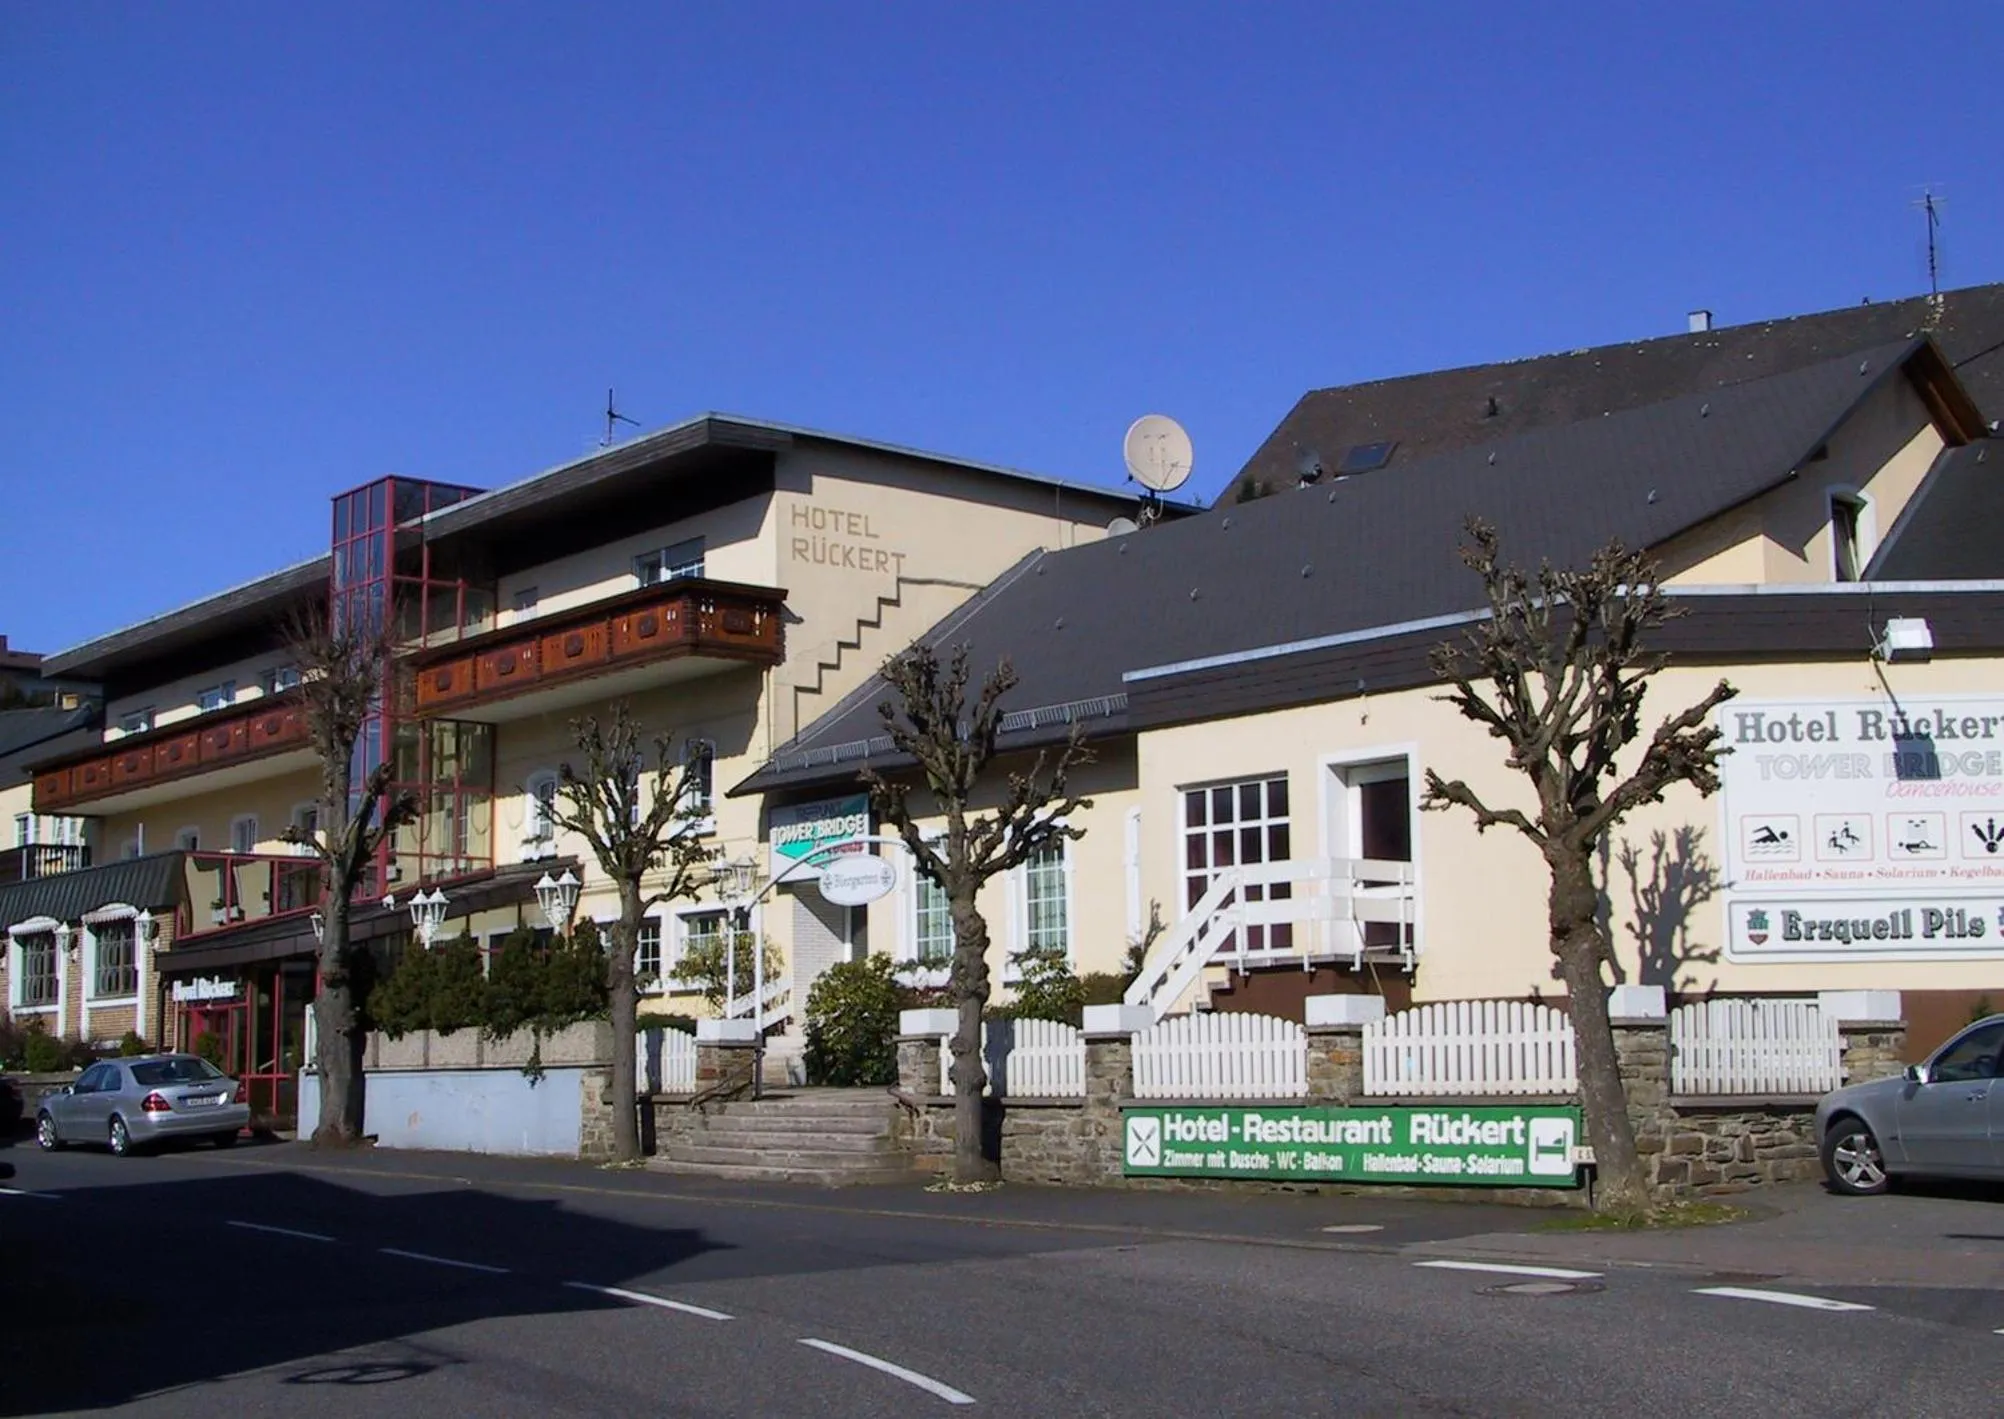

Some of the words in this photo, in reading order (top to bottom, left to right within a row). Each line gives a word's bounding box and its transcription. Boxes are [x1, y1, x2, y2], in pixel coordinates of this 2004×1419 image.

[791, 503, 880, 539] HOTEL
[791, 535, 907, 574] RÜCKERT
[1734, 710, 1840, 743] Hotel
[1755, 752, 1873, 780] TOWER
[1884, 750, 2002, 779] BRIDGE
[770, 823, 814, 846] TOWER
[817, 812, 865, 838] BRIDGE
[1823, 867, 1865, 880] Sauna
[1876, 866, 1938, 879] Solarium
[1781, 908, 1912, 944] Erzquell
[1921, 907, 1986, 939] Pils
[1409, 1112, 1526, 1146] Rückert
[1163, 1150, 1205, 1168] Zimmer
[1207, 1150, 1226, 1169] mit
